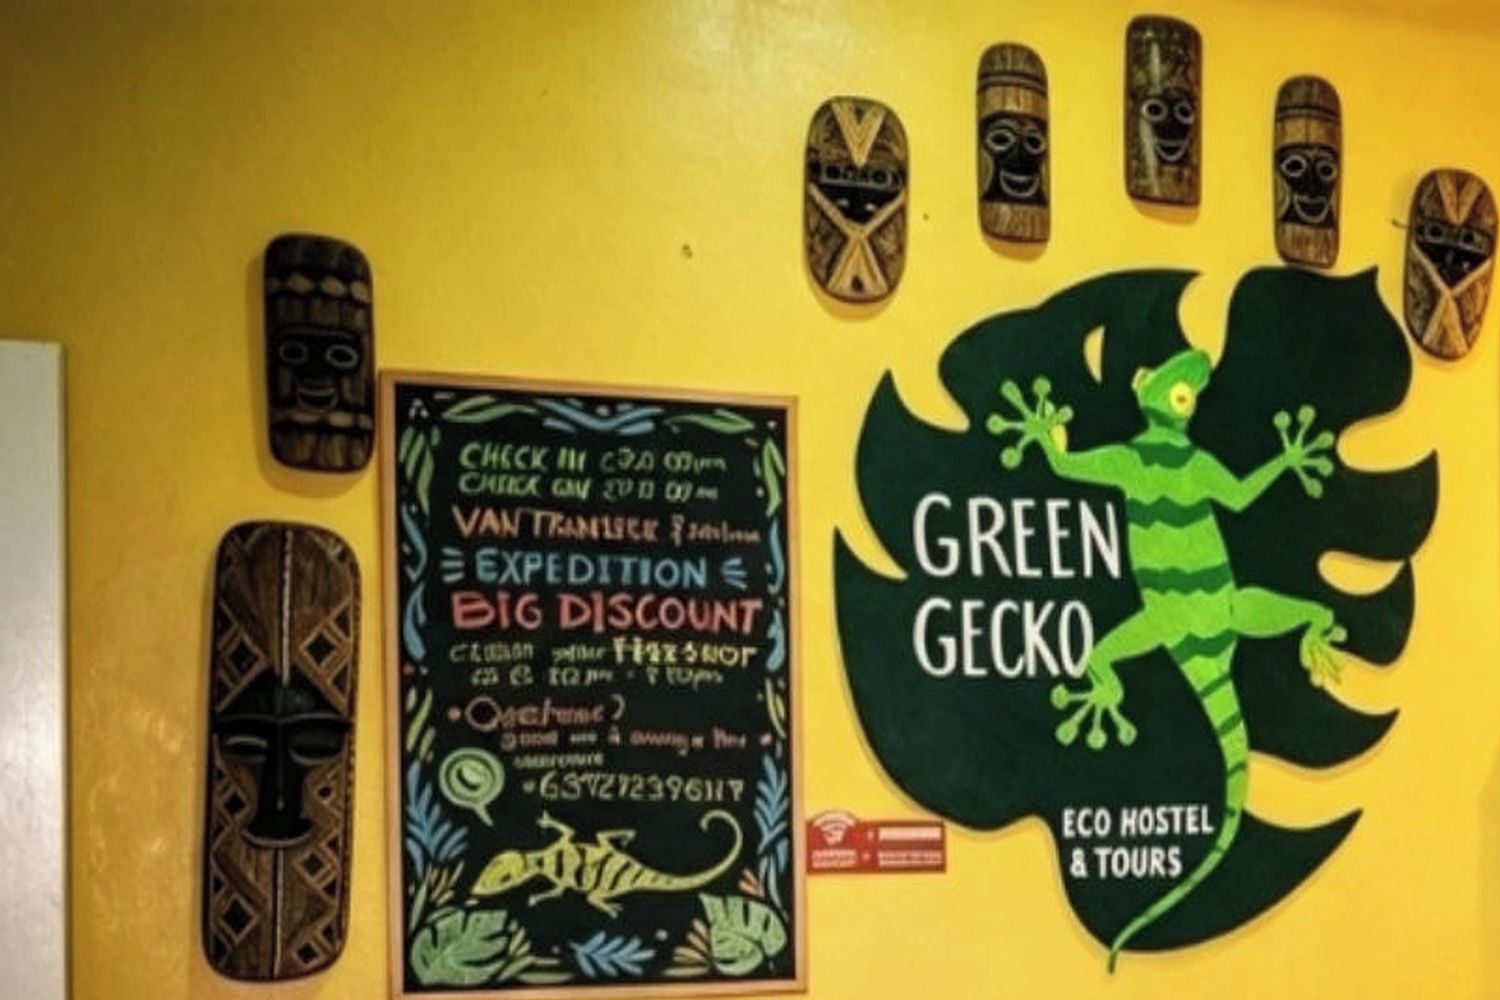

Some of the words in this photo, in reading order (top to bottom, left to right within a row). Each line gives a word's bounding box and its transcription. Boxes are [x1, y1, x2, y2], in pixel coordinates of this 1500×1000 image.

[913, 493, 1122, 579] GREEN
[475, 548, 708, 589] EXPEDITION
[452, 592, 542, 630] BIG
[559, 592, 763, 634] DISCOUNT
[913, 597, 1094, 679] GECKO
[1063, 809, 1111, 838] ECO
[1120, 805, 1214, 835] HOSTEL
[1069, 850, 1088, 877] &
[1094, 847, 1183, 878] TOURS
